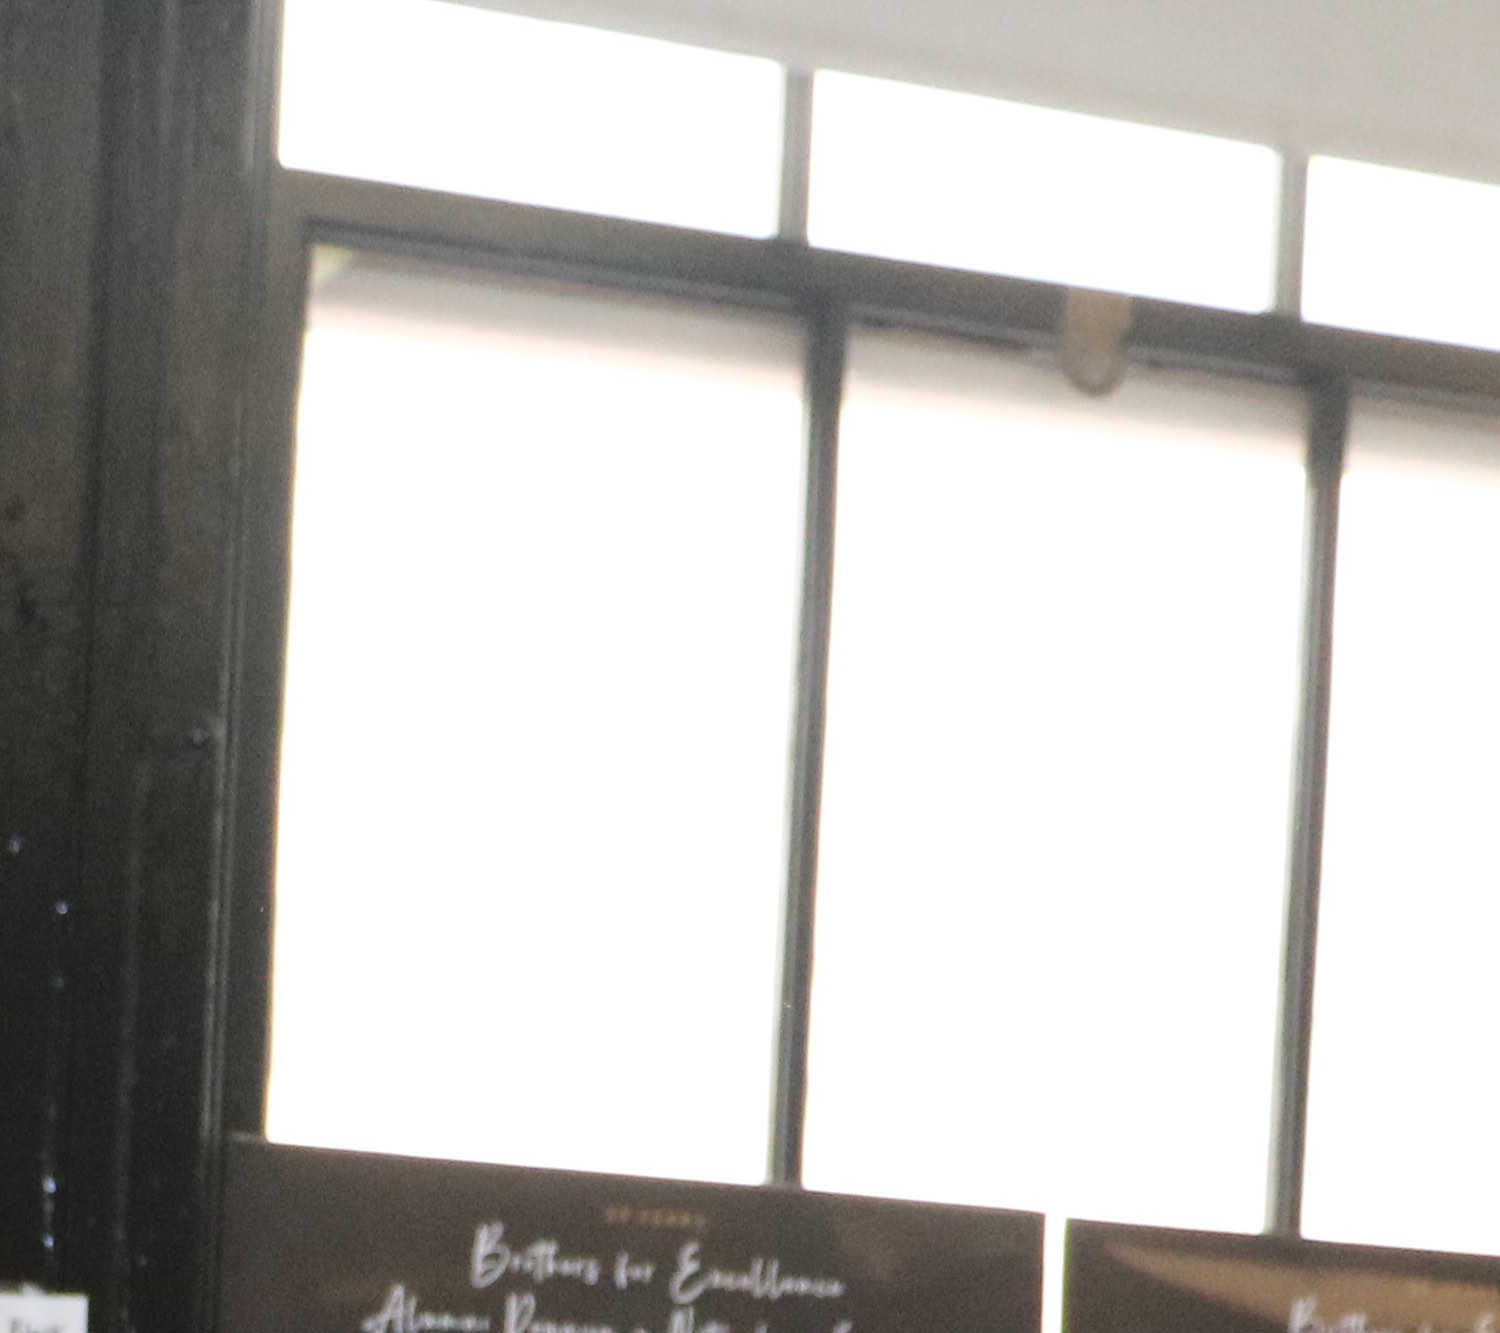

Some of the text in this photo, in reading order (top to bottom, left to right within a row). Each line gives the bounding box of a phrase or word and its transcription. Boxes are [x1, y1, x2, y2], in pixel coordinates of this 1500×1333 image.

[471, 1221, 847, 1301] Brothers for Excellence
